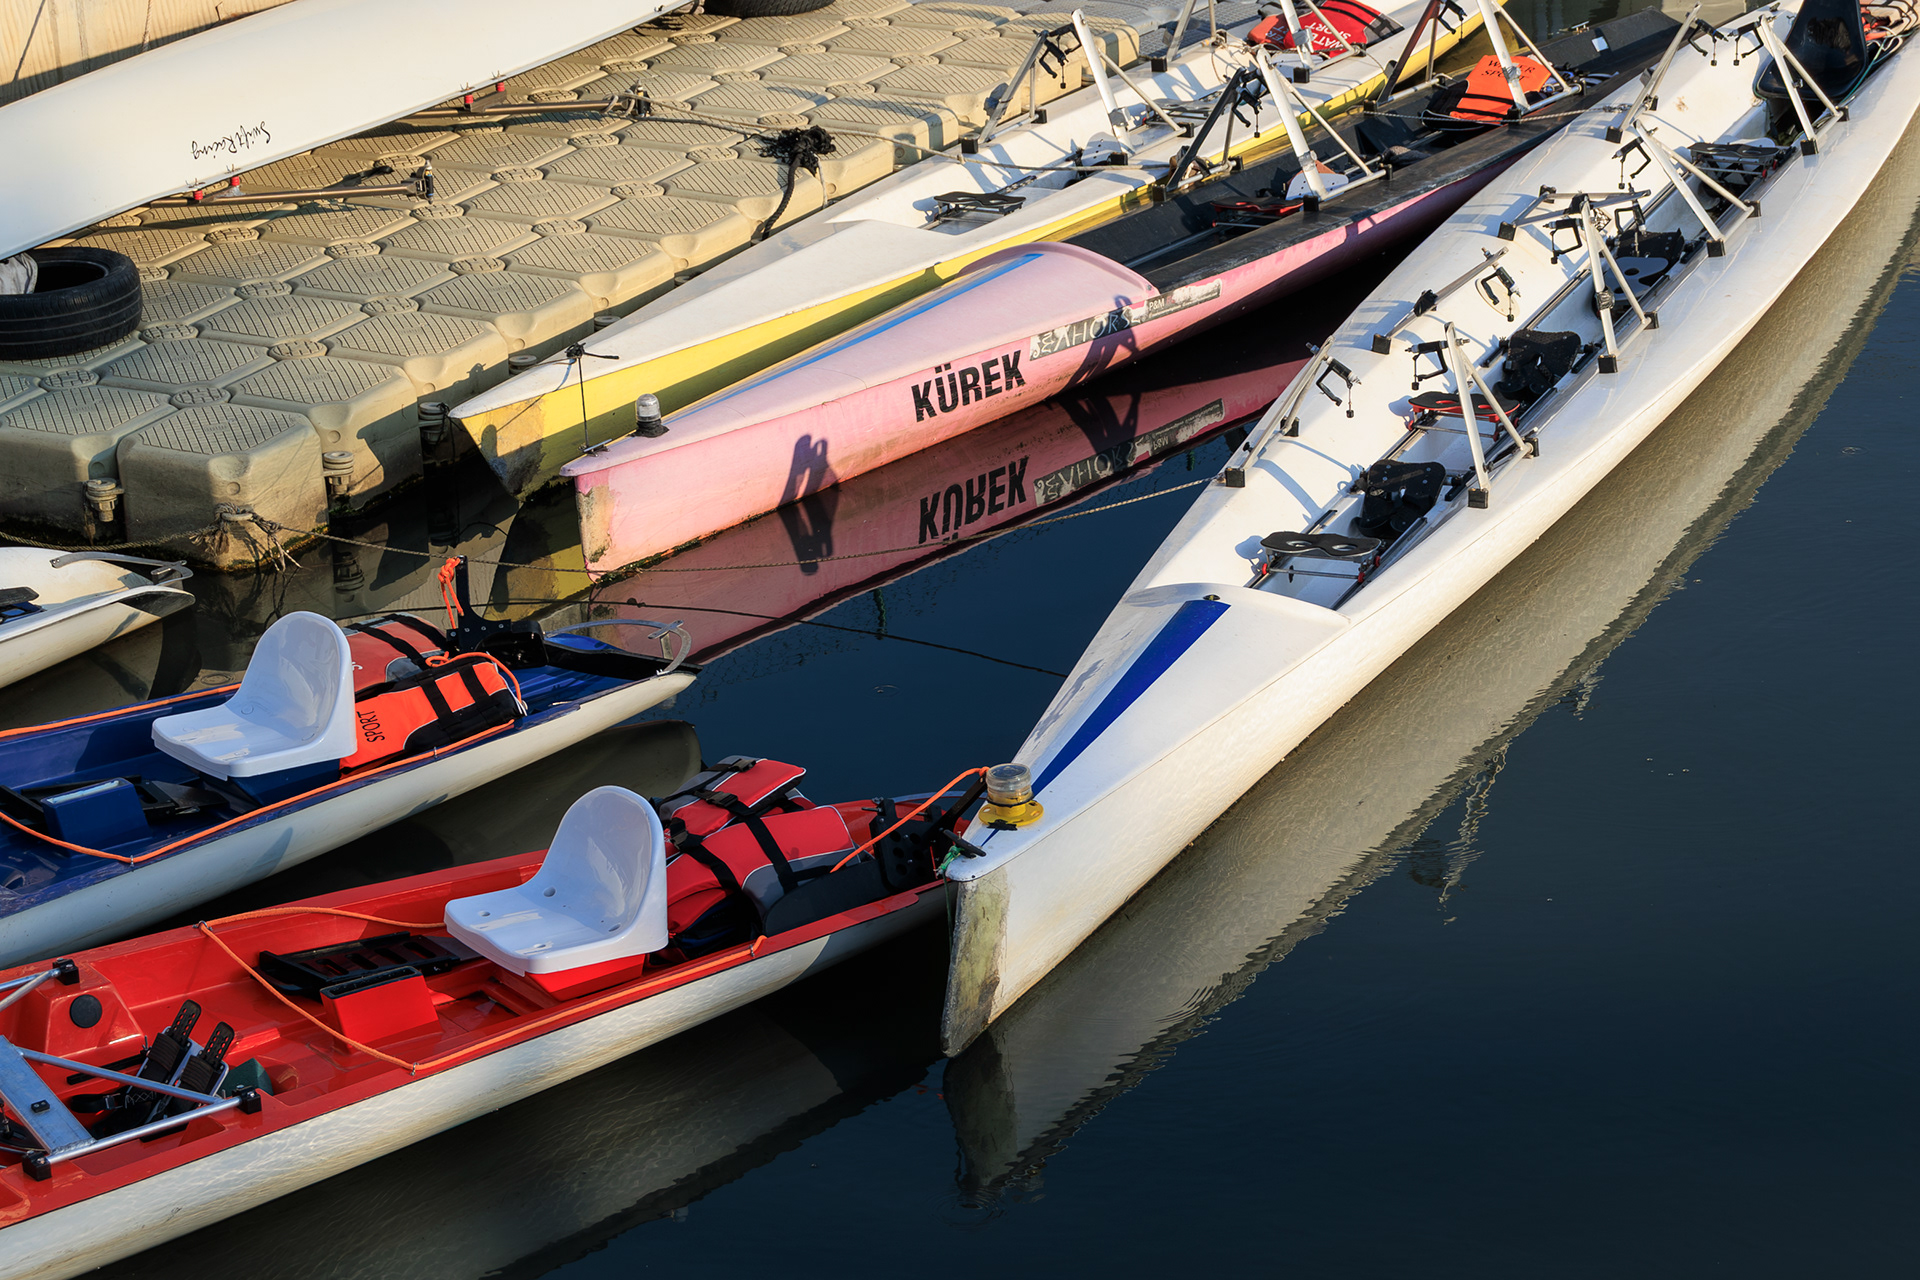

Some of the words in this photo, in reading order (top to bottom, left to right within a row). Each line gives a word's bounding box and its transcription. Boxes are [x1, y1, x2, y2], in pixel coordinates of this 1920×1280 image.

[190, 135, 237, 160] Racing
[235, 121, 271, 149] Swift
[911, 350, 1026, 422] KÜREK
[356, 710, 386, 743] SPORT
